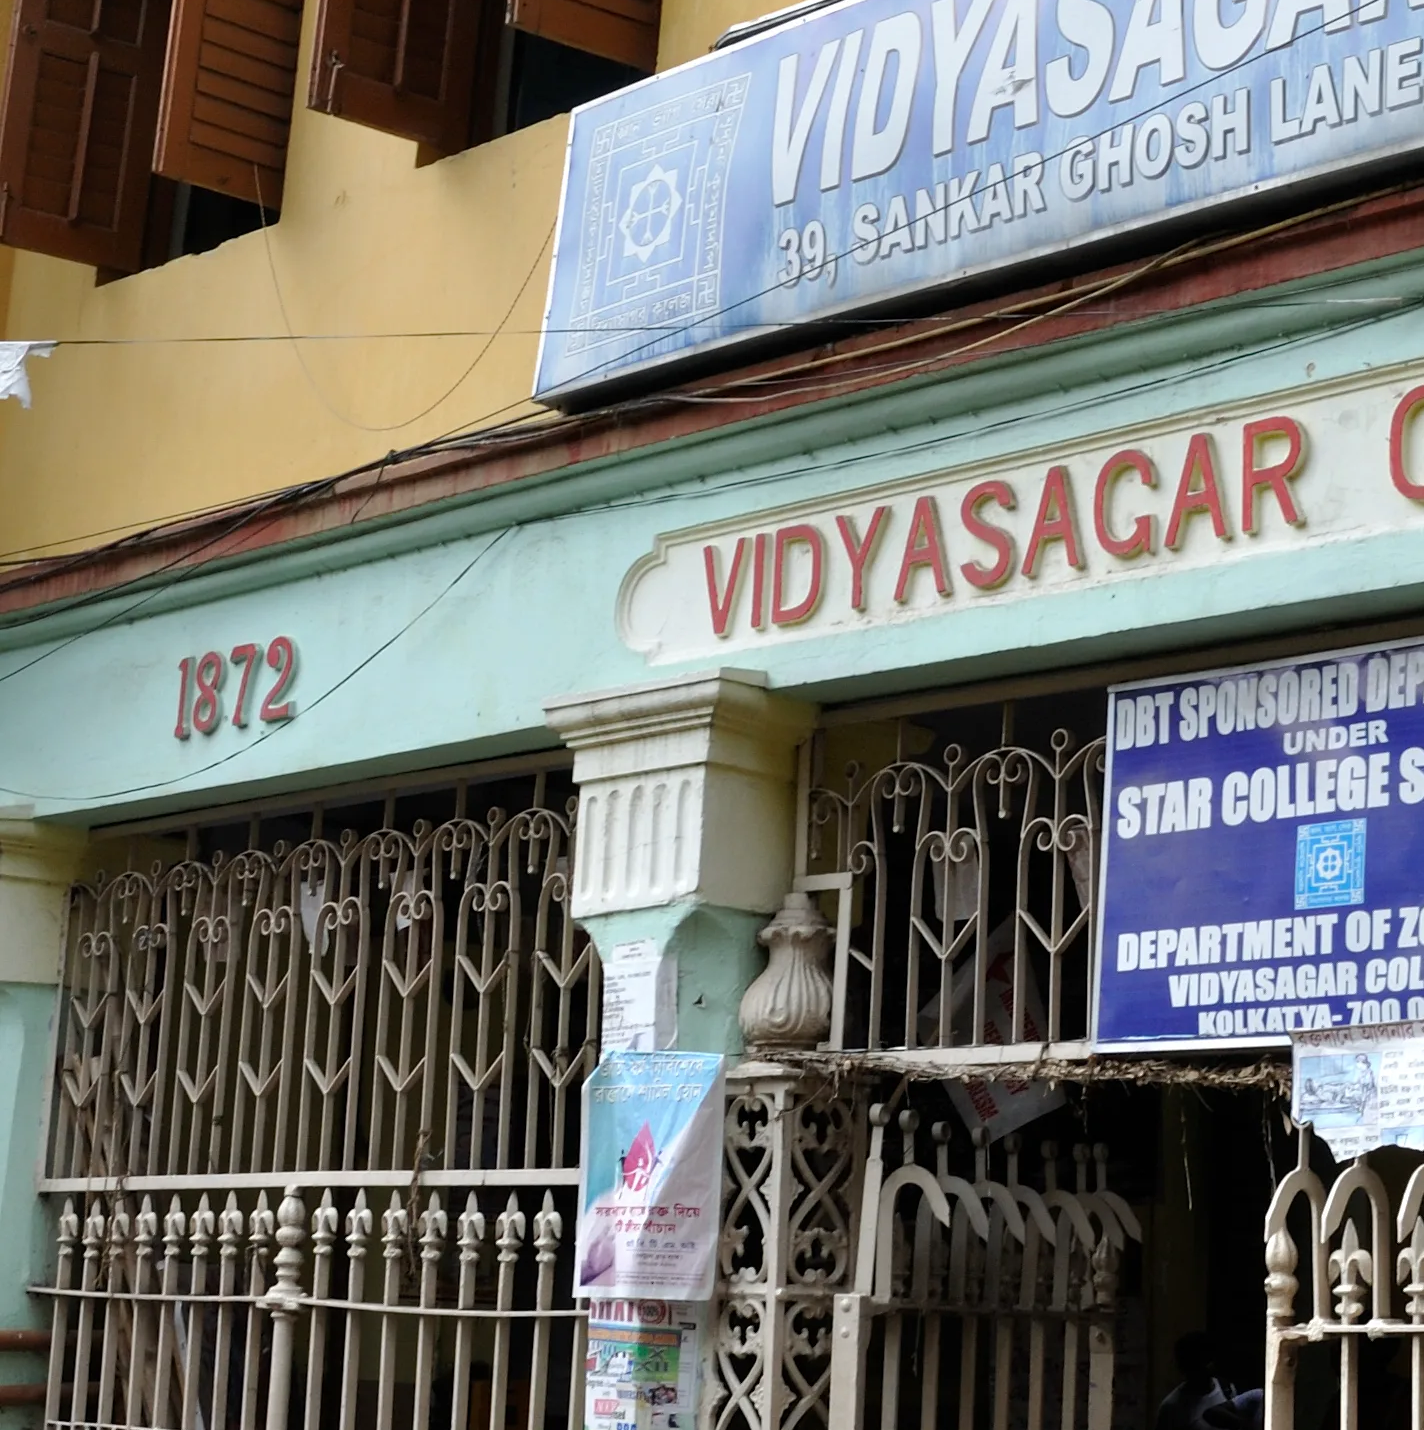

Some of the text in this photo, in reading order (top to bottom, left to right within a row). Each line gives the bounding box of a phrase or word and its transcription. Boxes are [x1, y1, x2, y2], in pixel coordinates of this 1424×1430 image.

[776, 227, 840, 290] 39,
[853, 151, 1048, 274] SANKAR
[1060, 87, 1255, 203] GHOSH
[703, 416, 1306, 637] VIDYASAGAR
[173, 636, 297, 739] 1872
[1116, 689, 1173, 751] DBT
[1179, 661, 1359, 738] SPONSORED
[1283, 719, 1388, 755] UNDER
[1117, 777, 1213, 839] STAR
[1221, 752, 1390, 826] COLLEGE
[1117, 913, 1338, 972] DEPARTMENT
[1345, 911, 1391, 951] OF
[1168, 961, 1358, 1008] VIDYASAGAR
